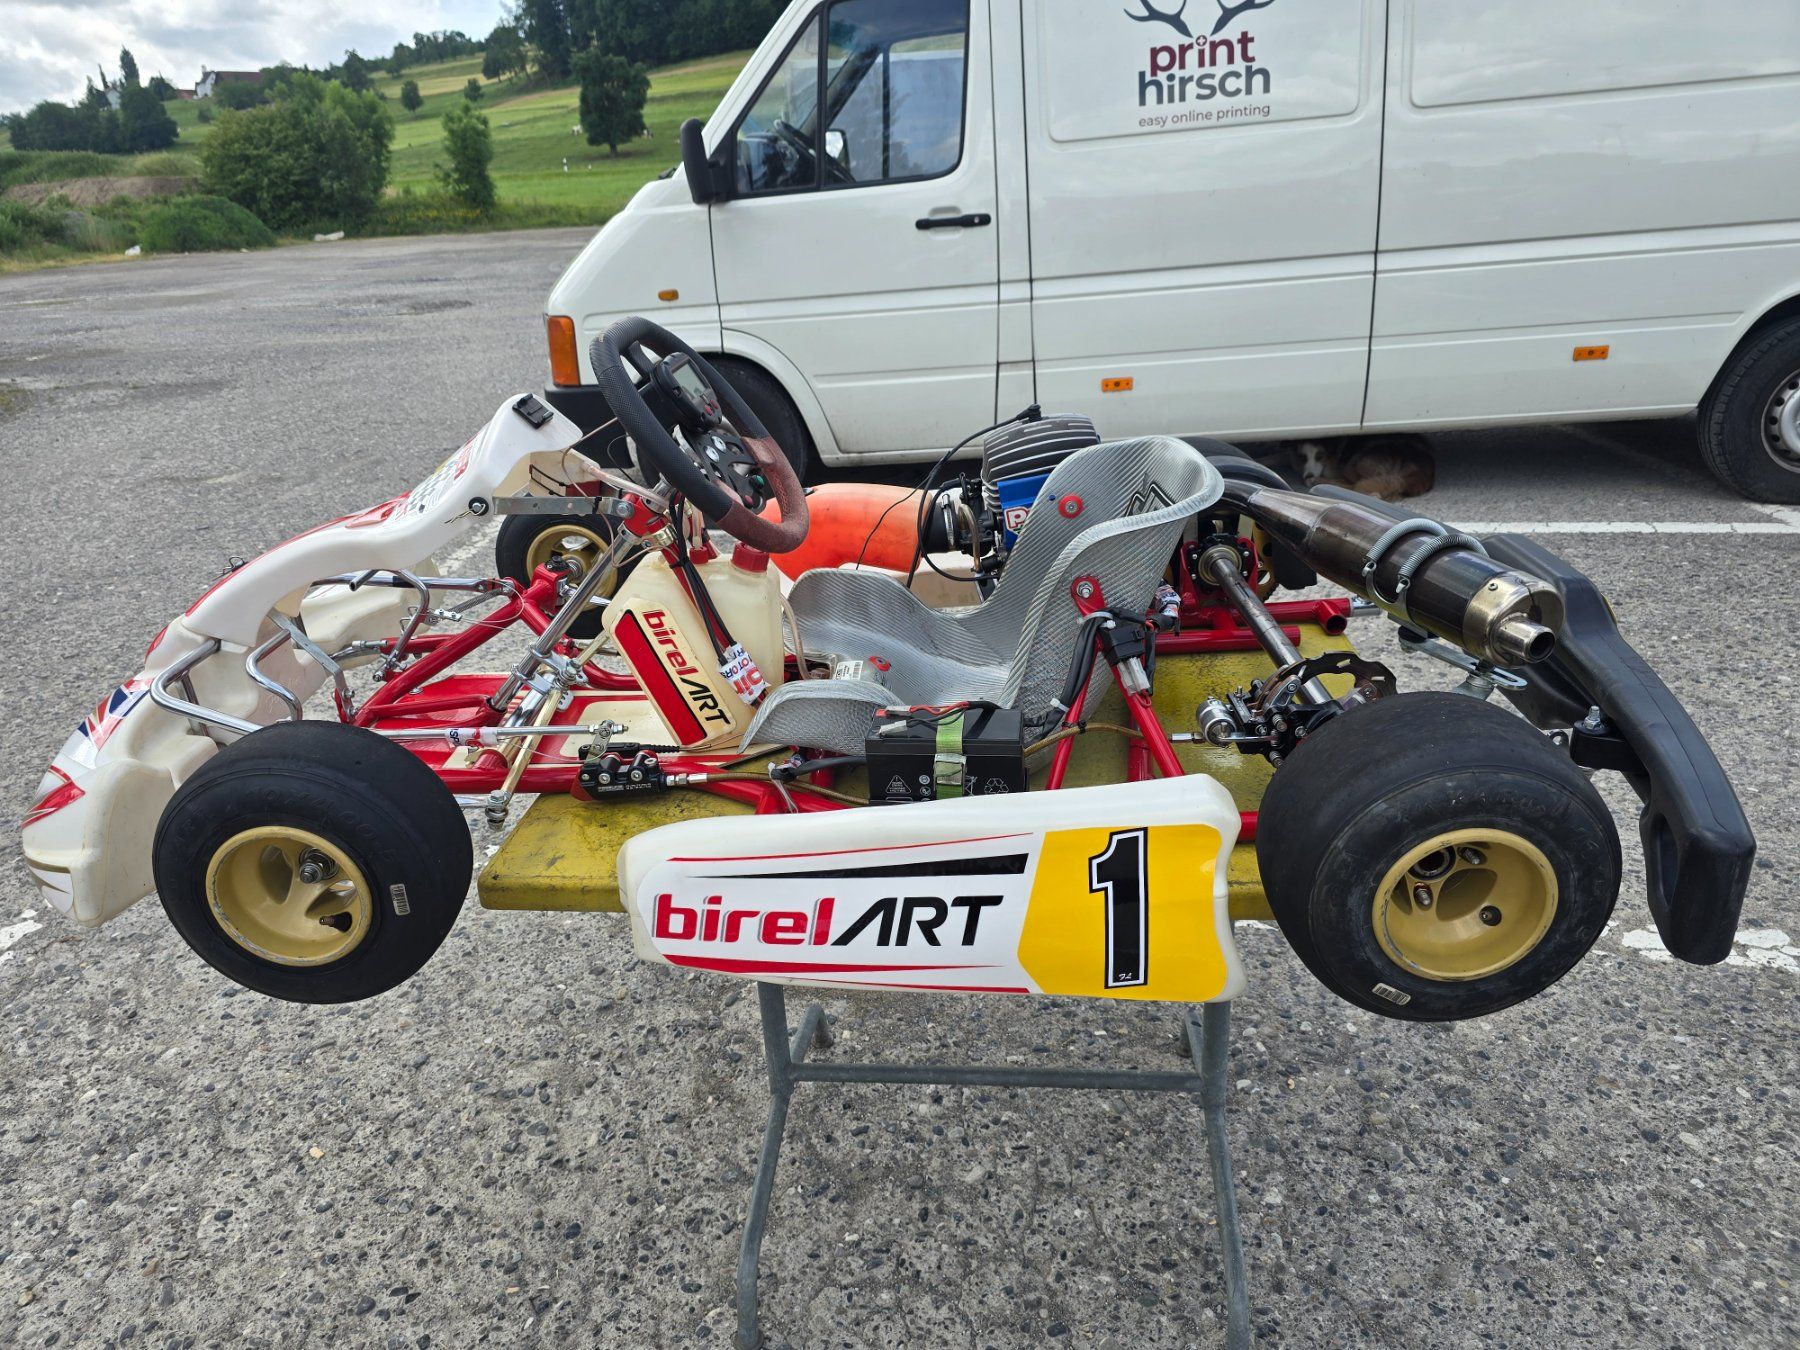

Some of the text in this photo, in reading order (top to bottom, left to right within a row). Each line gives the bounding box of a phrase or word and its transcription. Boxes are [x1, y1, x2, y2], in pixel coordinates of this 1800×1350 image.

[1150, 31, 1256, 77] print
[1138, 65, 1271, 106] hirsch
[1139, 104, 1271, 128] easy online printing
[1088, 827, 1148, 989] 1
